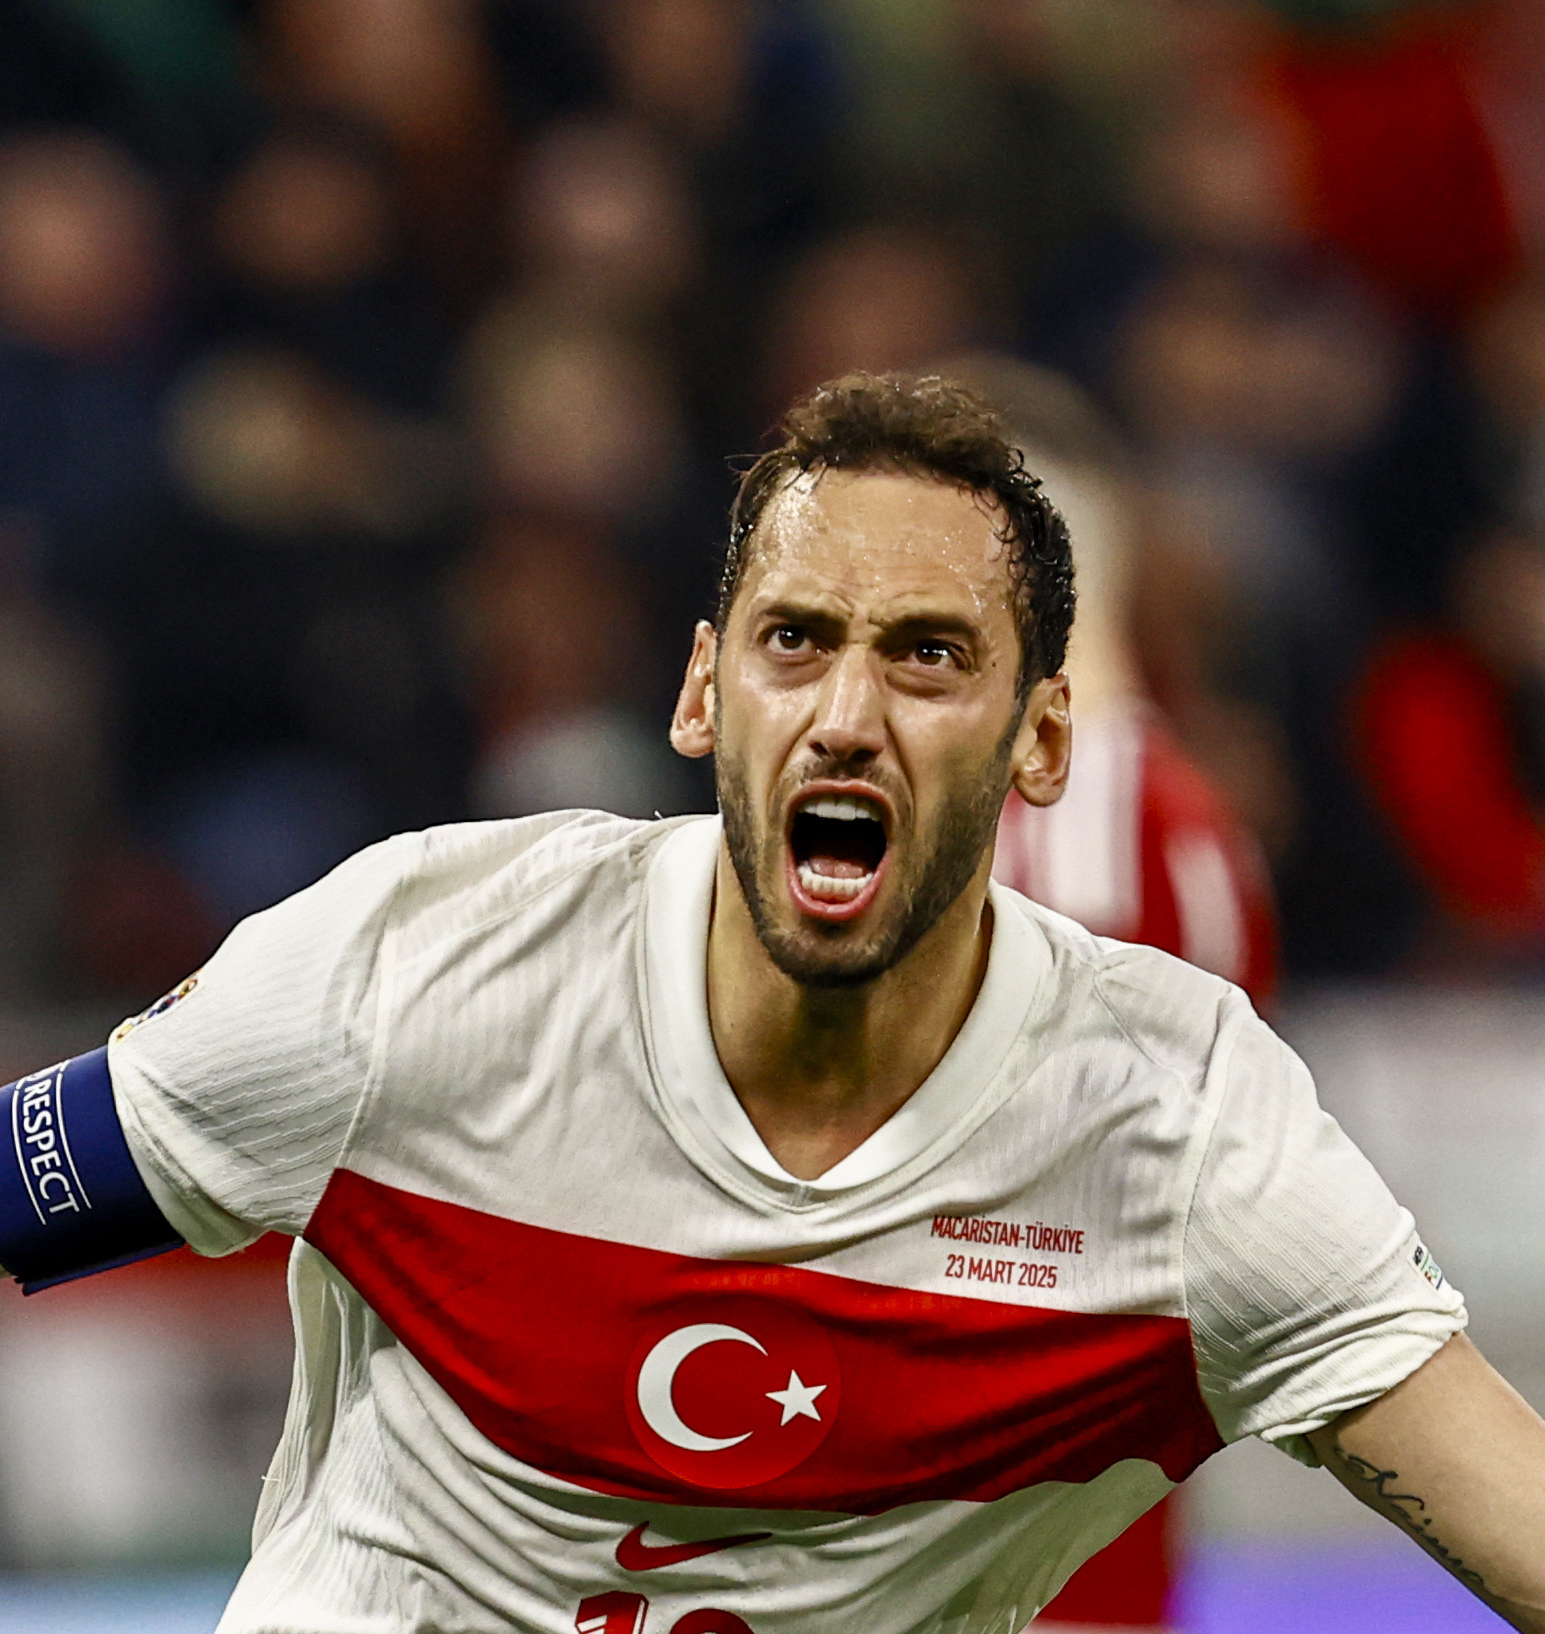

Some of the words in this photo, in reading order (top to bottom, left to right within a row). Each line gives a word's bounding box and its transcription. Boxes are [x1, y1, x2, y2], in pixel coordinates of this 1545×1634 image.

[22, 1078, 80, 1214] RESPECT
[930, 1214, 1085, 1254] MACARİSTAN-TÜRKİYE
[945, 1254, 965, 1279] 23
[967, 1256, 1016, 1285] MART
[1018, 1263, 1058, 1289] 2025
